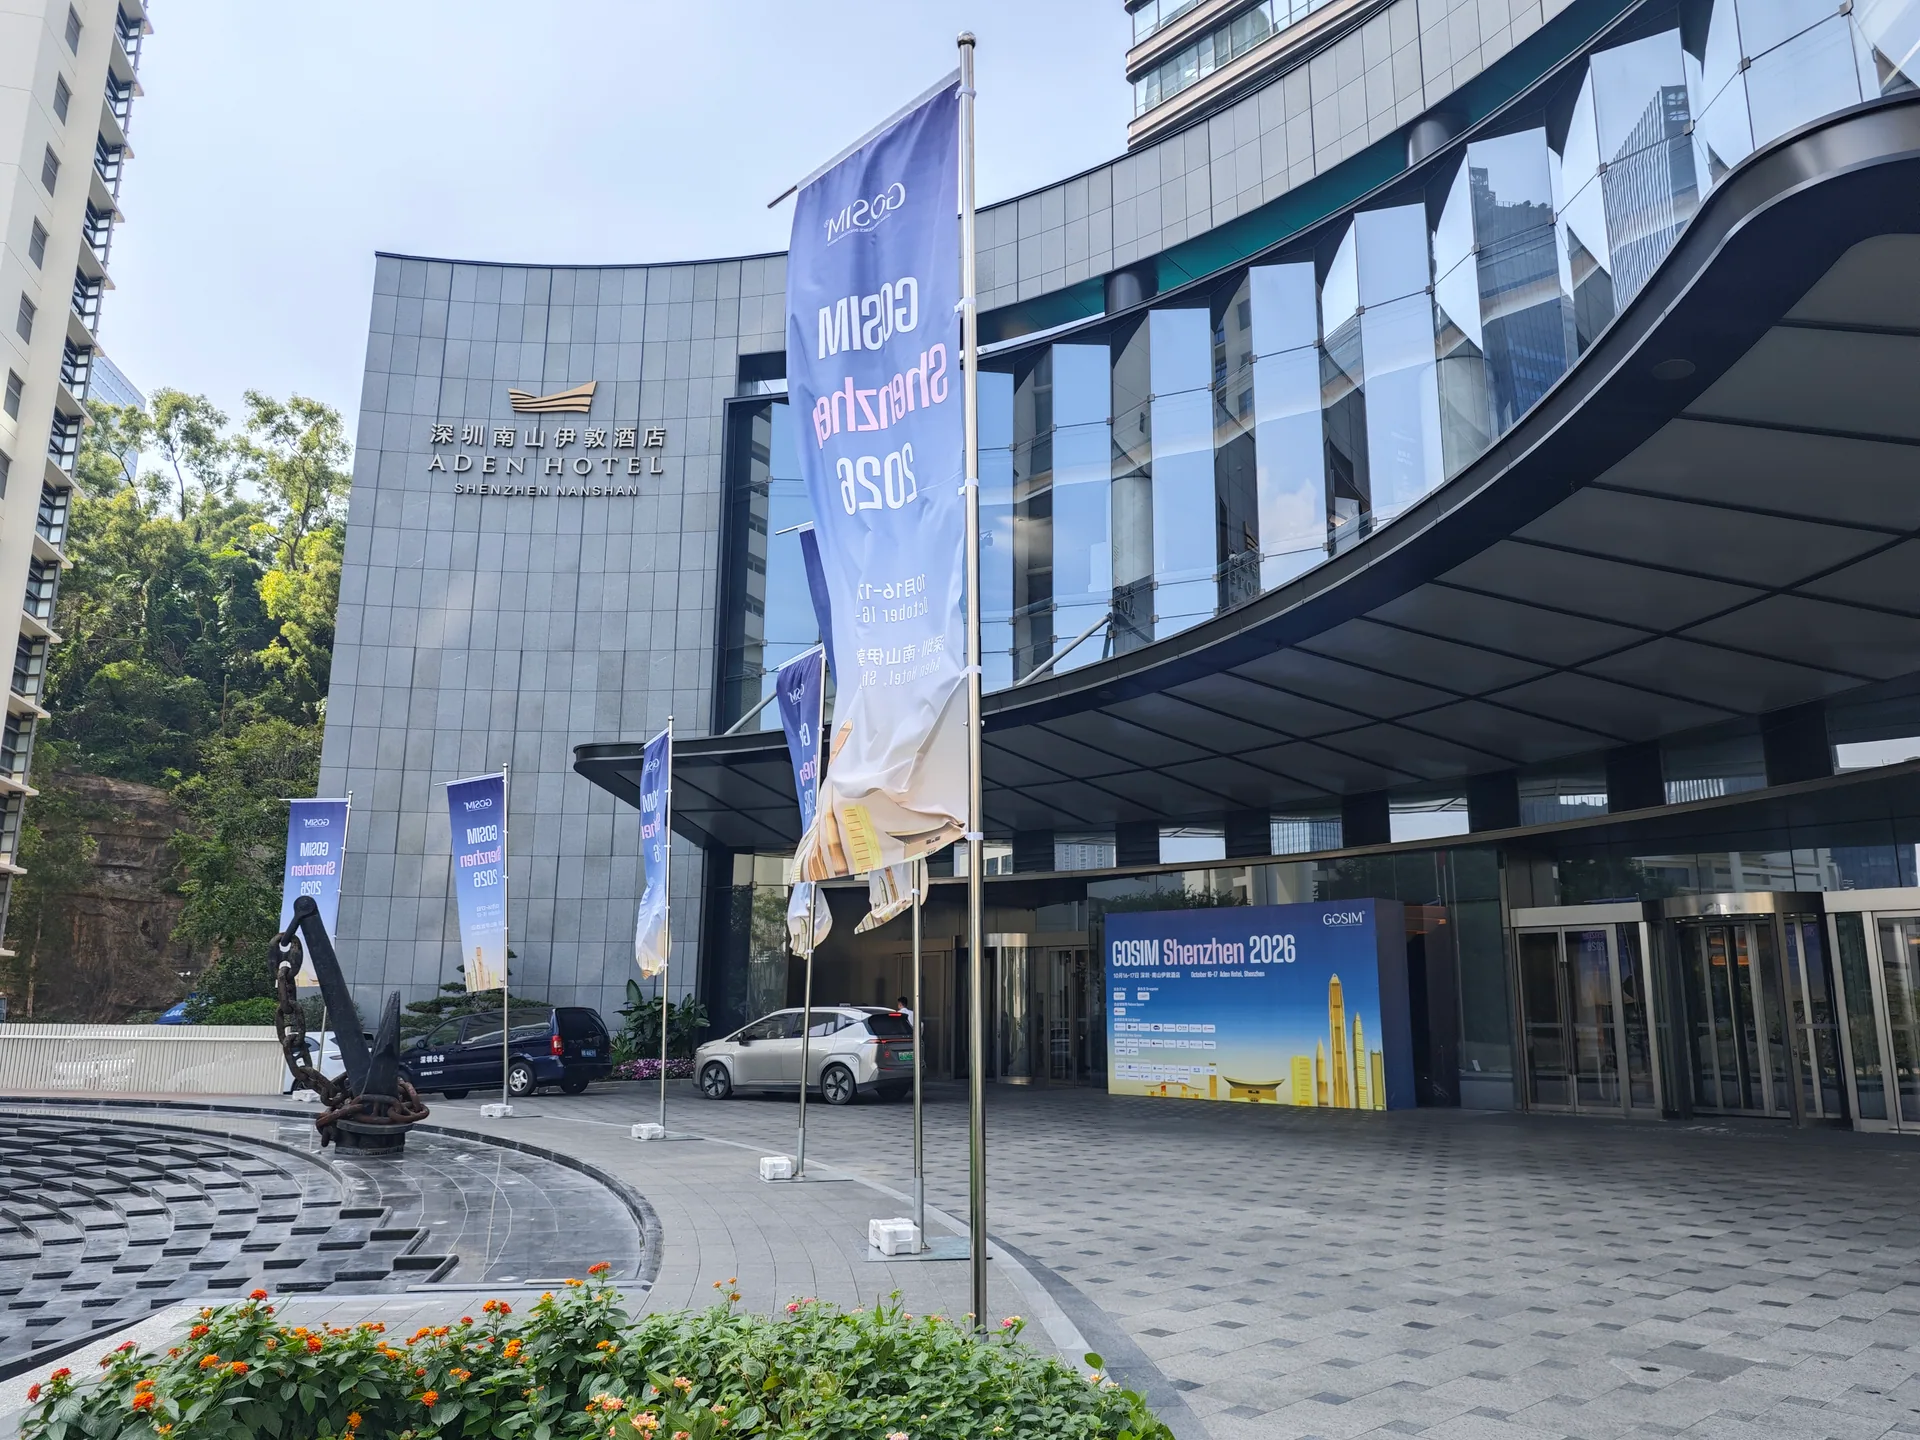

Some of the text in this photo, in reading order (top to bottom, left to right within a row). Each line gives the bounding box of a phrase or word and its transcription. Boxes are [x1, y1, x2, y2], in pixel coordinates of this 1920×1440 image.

[430, 423, 667, 449] 深圳南山伊敦酒店
[427, 453, 664, 476] ADEN HOTEL
[454, 483, 639, 497] SHENZHEN NANSHAN
[1322, 911, 1363, 925] GOSIM
[1112, 934, 1296, 967] GOSIM Shenzhen 2026
